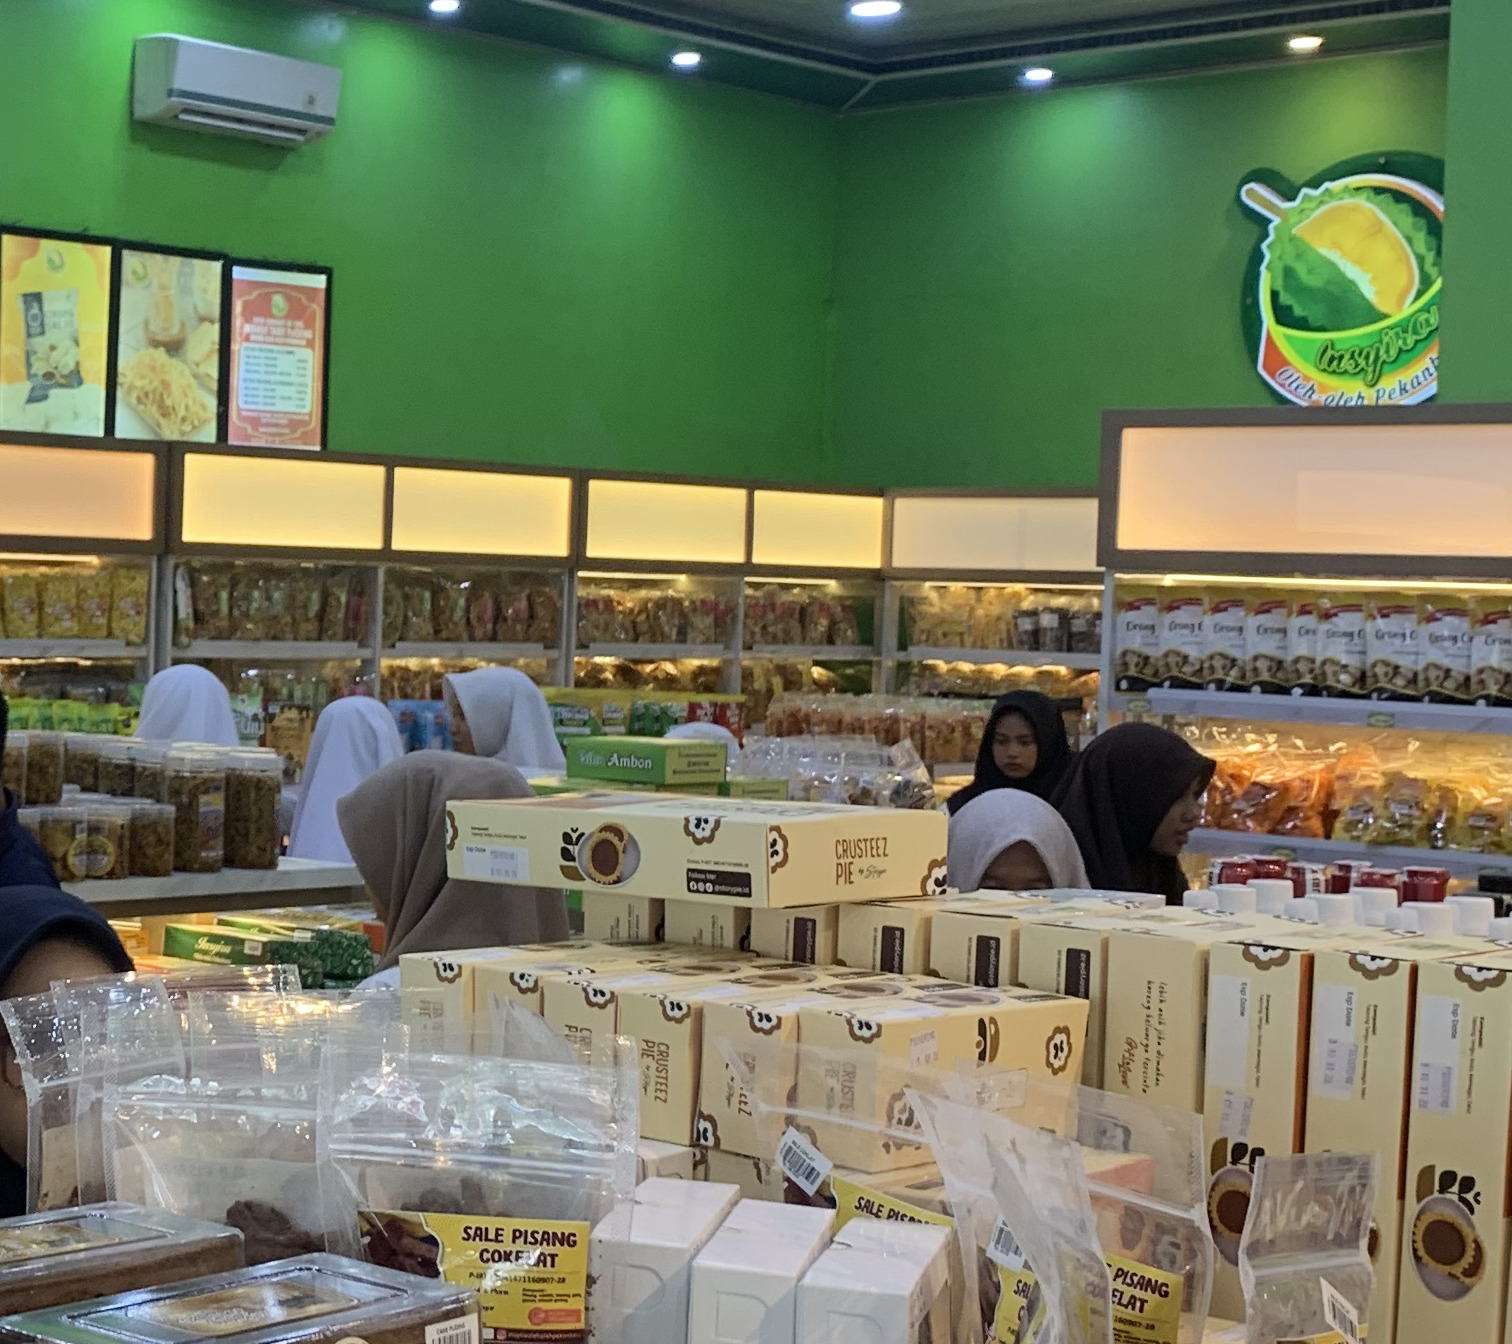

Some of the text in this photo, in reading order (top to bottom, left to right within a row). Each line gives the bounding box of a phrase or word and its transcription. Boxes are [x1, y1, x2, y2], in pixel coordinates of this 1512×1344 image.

[608, 752, 652, 769] Ambon
[834, 837, 889, 860] CRUSTEEZ
[835, 862, 856, 886] PIE
[641, 1039, 656, 1061] PIE
[654, 1042, 670, 1104] CRUSTEEZ
[854, 1196, 885, 1218] SALE
[461, 1225, 578, 1248] SALE PISANG
[479, 1248, 559, 1268] COKEAT
[1112, 1267, 1170, 1299] PISANG
